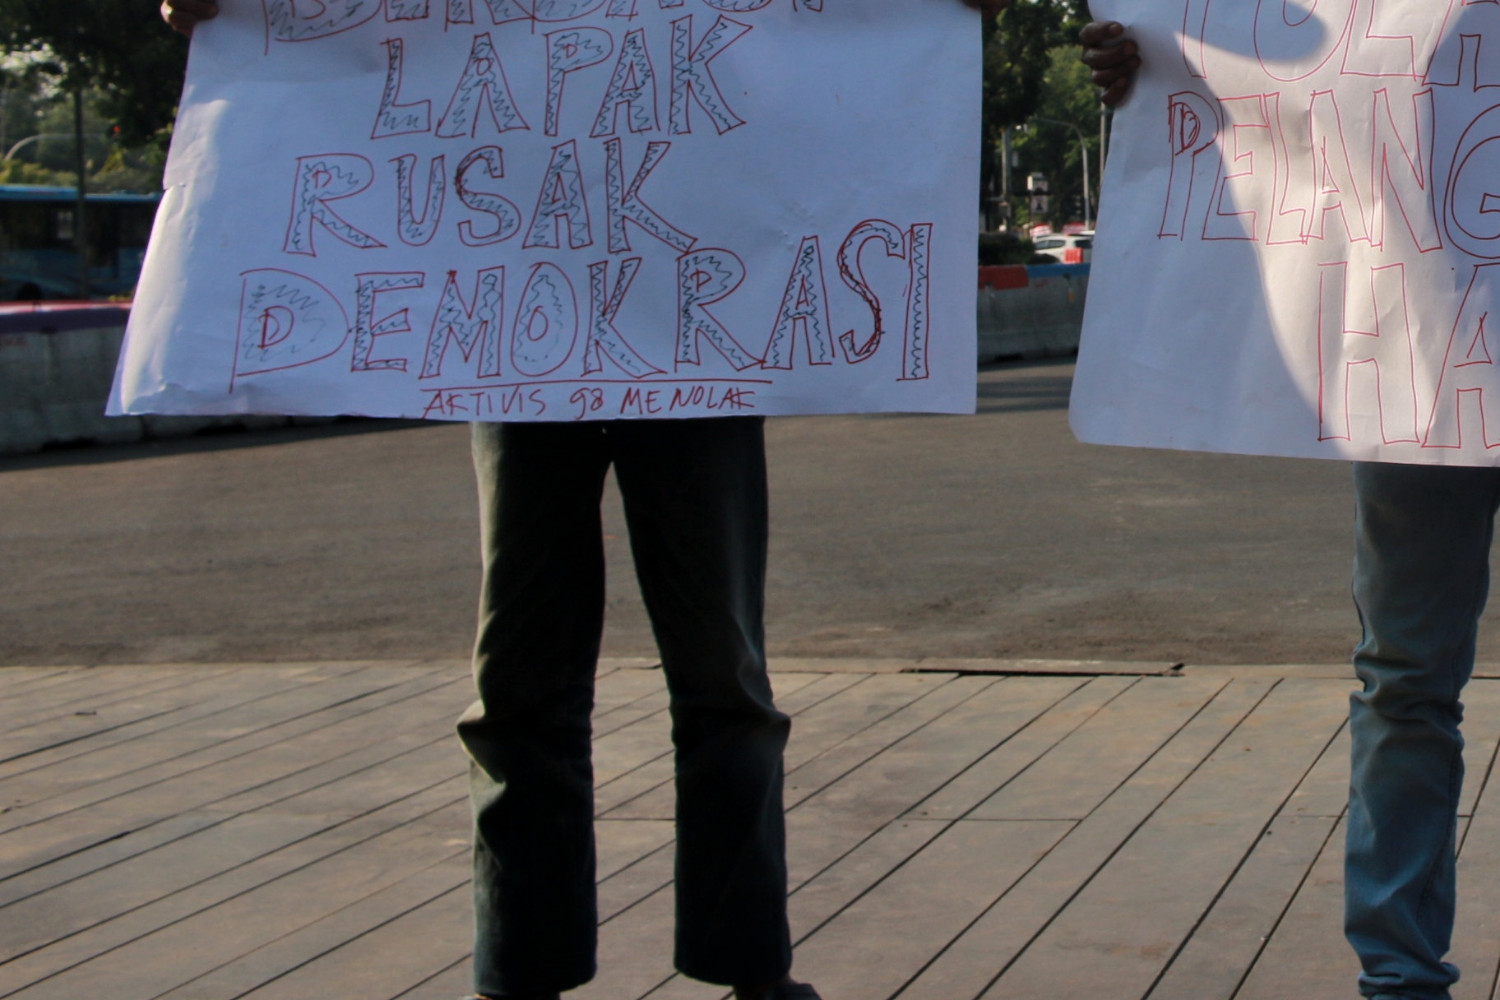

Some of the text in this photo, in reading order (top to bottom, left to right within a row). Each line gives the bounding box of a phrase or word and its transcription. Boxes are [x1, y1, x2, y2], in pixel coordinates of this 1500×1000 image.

[370, 14, 754, 139] LAPAK
[284, 138, 697, 257] RUSAK
[230, 220, 933, 394] DEMOKRASI
[422, 384, 756, 420] AKTIVIS 98 MENOLAK
